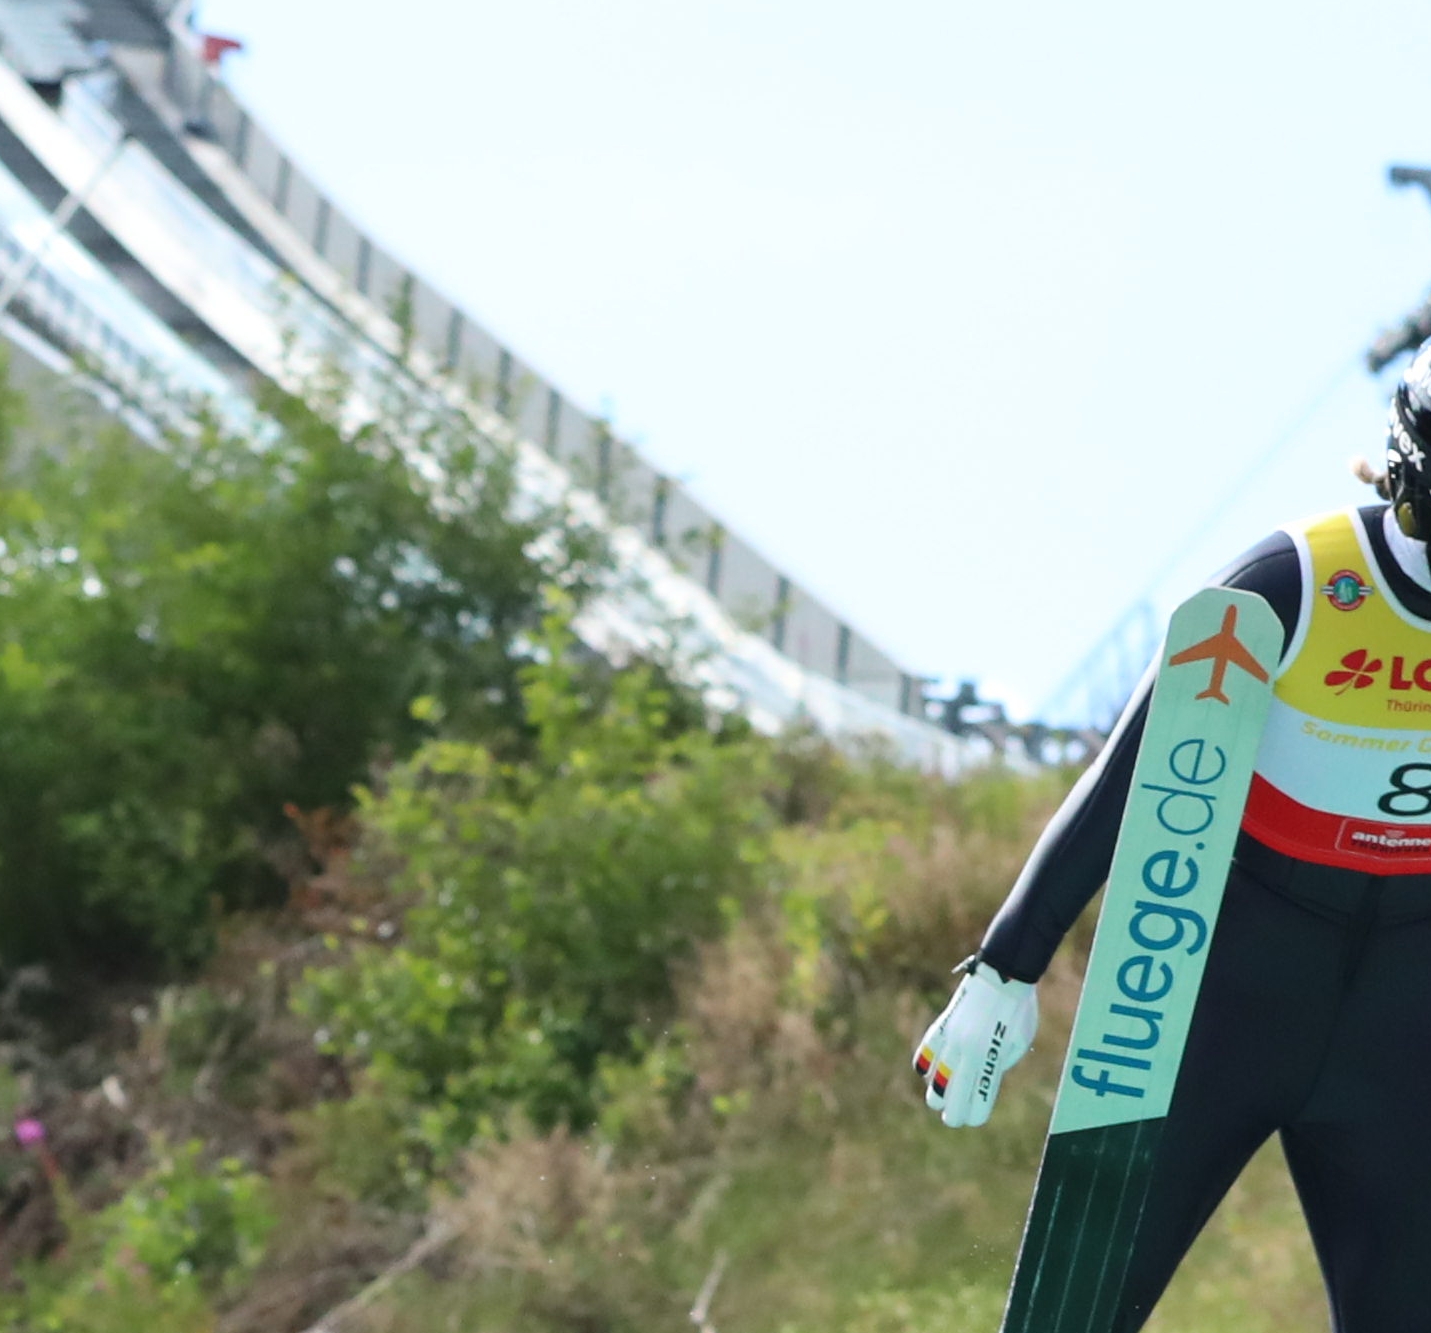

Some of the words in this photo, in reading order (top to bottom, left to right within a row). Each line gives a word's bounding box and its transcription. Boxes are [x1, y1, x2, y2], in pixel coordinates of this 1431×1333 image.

[1302, 720, 1413, 753] Sommer
[1070, 738, 1227, 1099] fluege.de
[977, 1020, 1007, 1102] ziener
